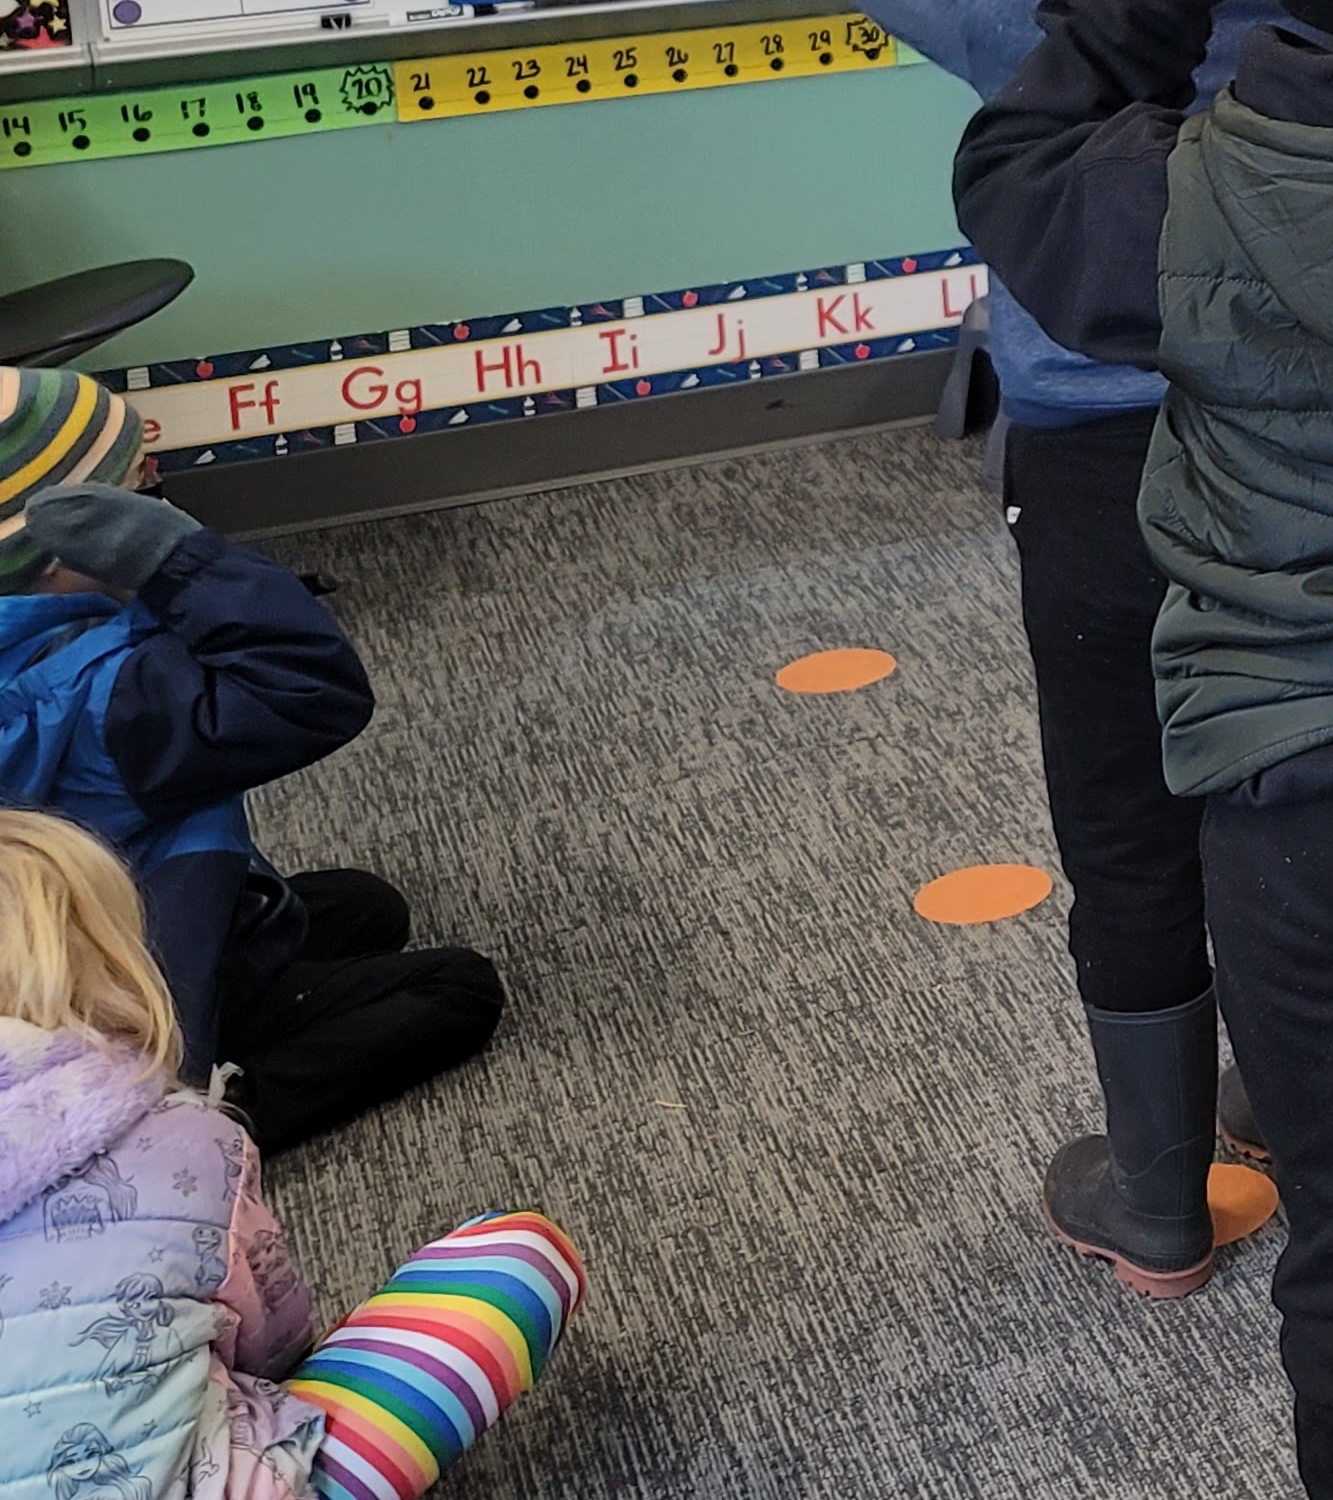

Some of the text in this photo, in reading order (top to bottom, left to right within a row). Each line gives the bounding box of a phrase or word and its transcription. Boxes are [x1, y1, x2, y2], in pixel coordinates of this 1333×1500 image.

[612, 47, 638, 70] 25
[760, 34, 785, 57] 28
[410, 71, 431, 92] 21
[511, 59, 541, 81] 23
[2, 116, 31, 137] 14
[121, 104, 153, 123] 16
[816, 294, 875, 340] Kk
[600, 329, 640, 375] Ii
[708, 311, 748, 364] Jj
[474, 343, 541, 394] Hh
[229, 379, 281, 433] Ff
[340, 366, 424, 415] Gg
